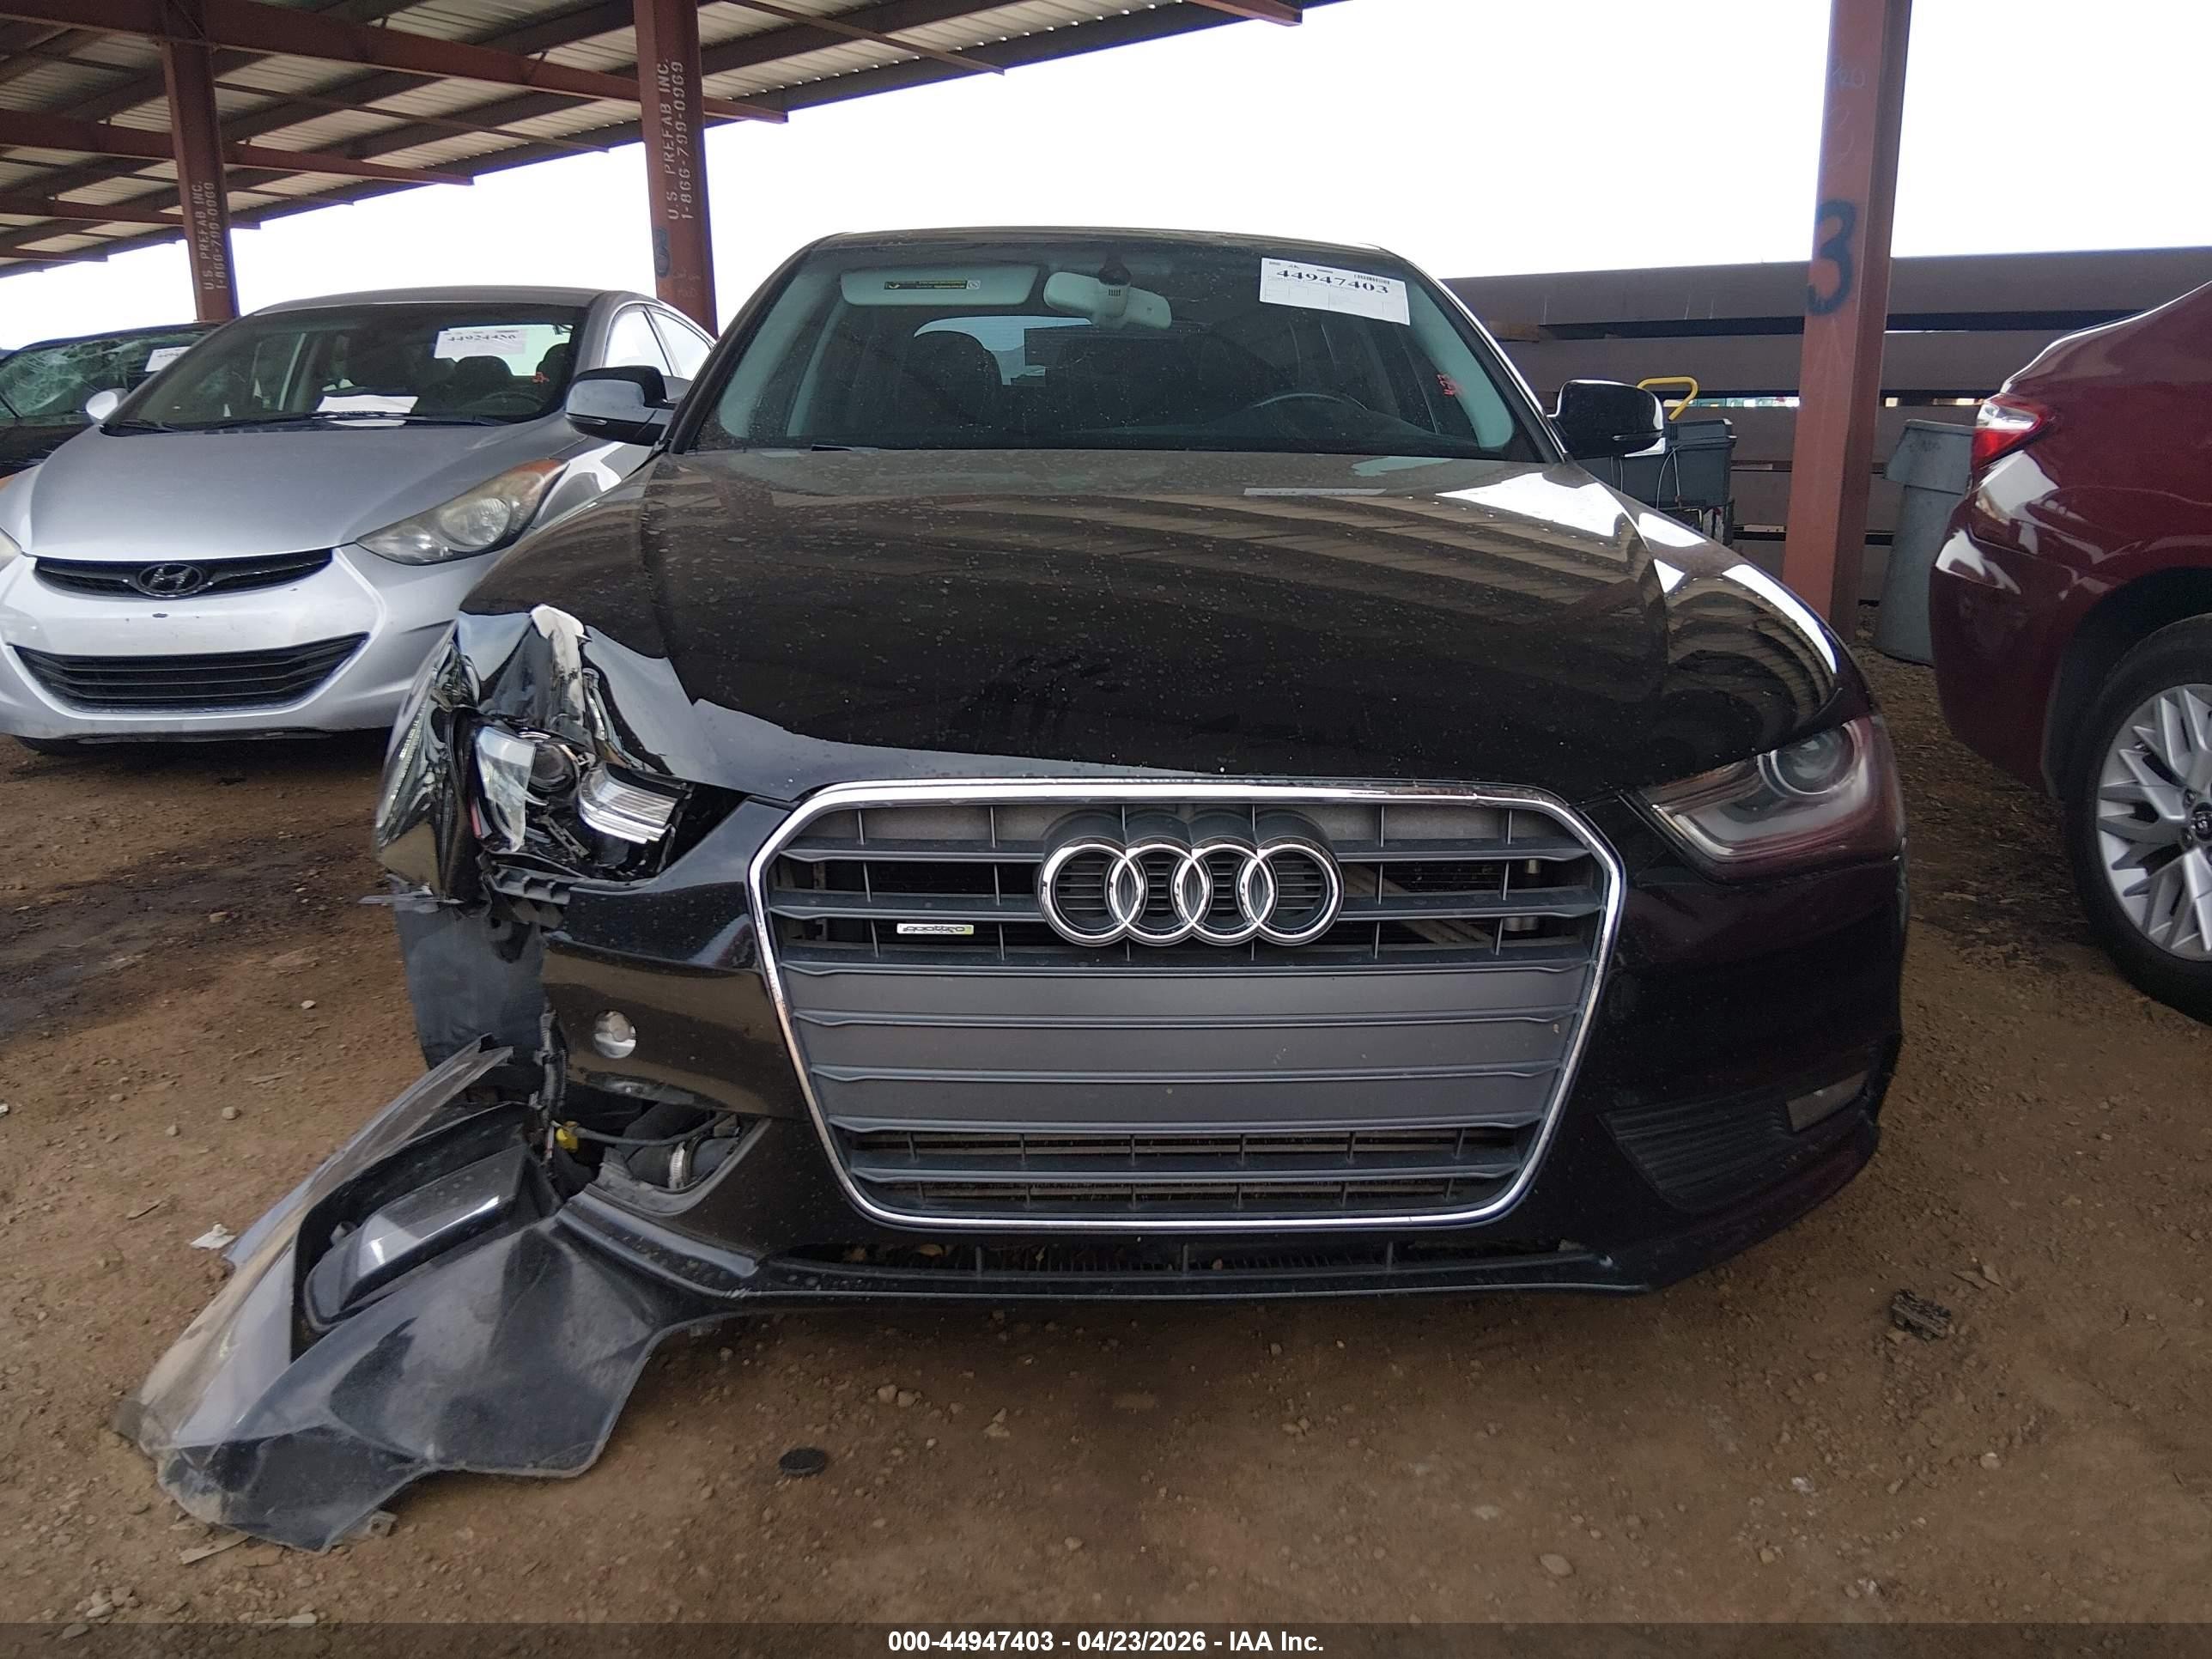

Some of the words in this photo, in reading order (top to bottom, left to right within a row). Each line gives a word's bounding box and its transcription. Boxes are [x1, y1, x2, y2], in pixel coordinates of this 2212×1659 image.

[657, 59, 672, 93] INC.
[659, 102, 676, 174] PREFAB
[194, 210, 211, 259] PREFAB
[1807, 199, 1857, 316] 3
[1276, 269, 1389, 294] 44947403
